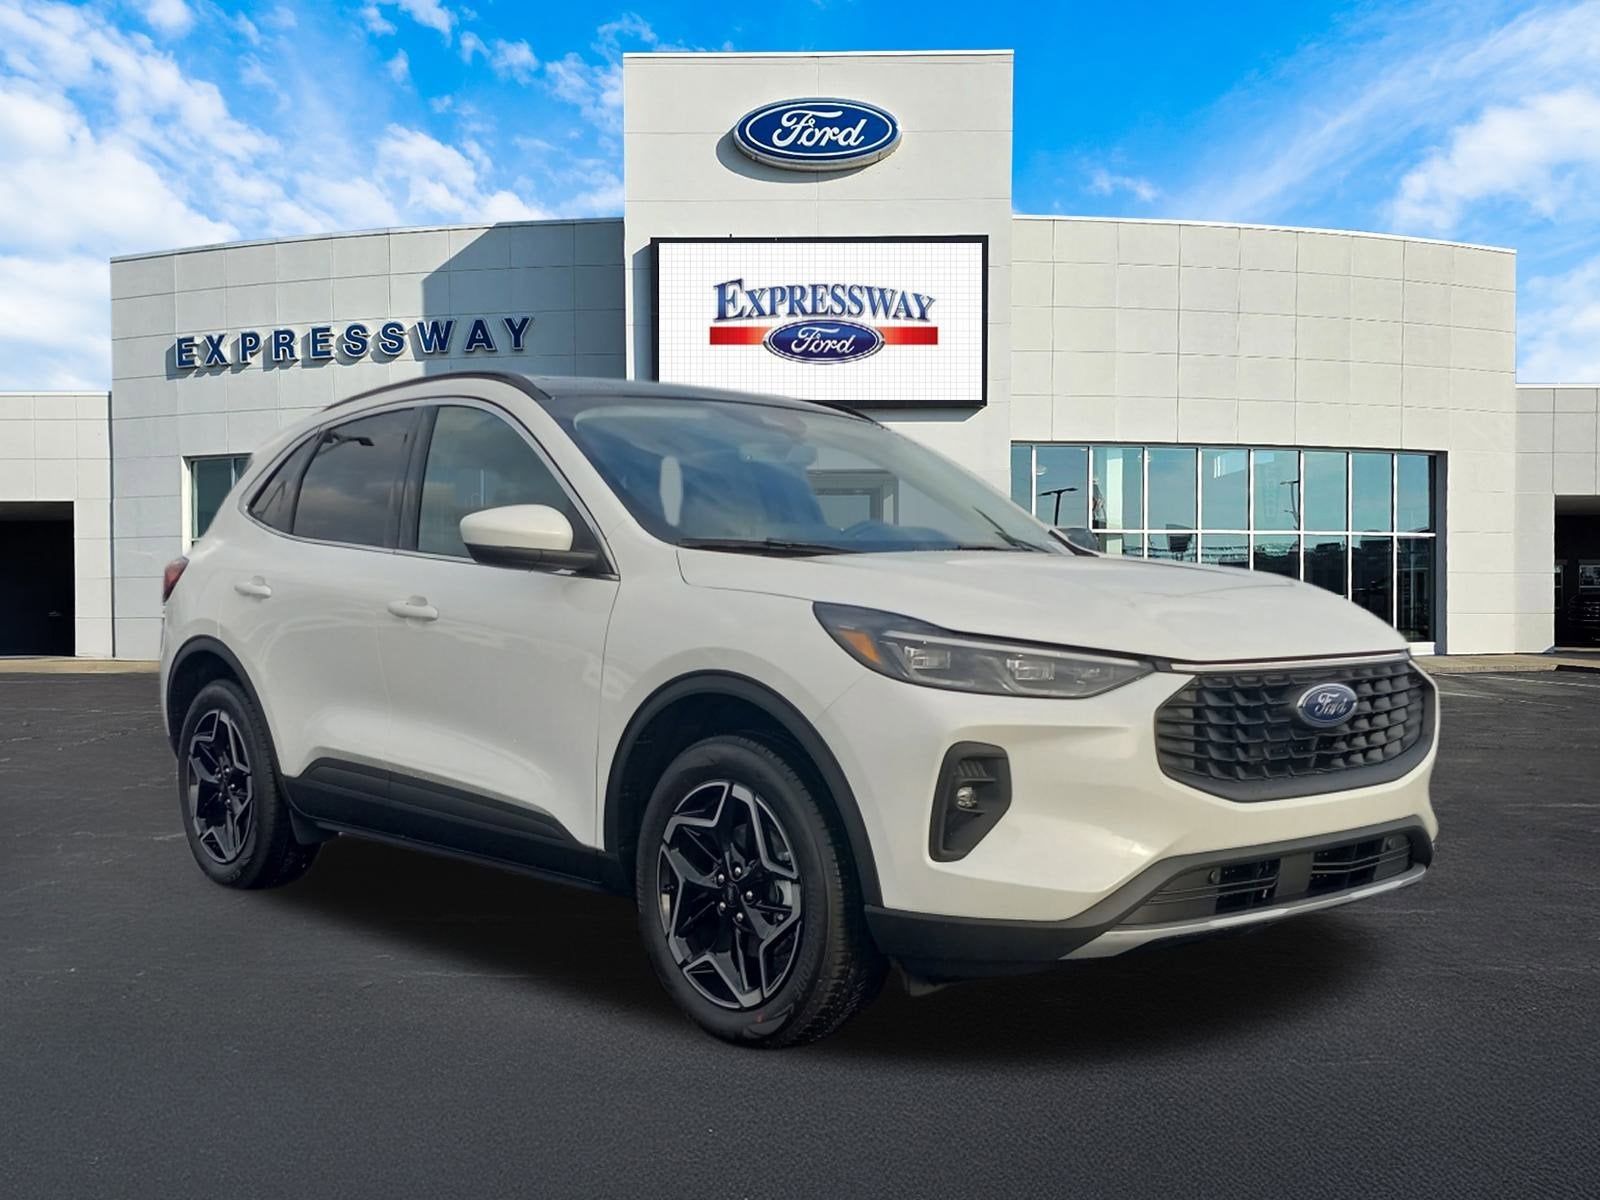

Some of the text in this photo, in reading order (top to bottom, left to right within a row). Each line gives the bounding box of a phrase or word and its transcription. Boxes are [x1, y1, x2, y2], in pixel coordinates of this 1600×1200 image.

[772, 110, 867, 147] Ford
[713, 278, 936, 322] EXPRESSWAY
[175, 316, 533, 368] EXPRESSWAY
[791, 327, 855, 354] Ford
[1314, 692, 1348, 715] Ford
